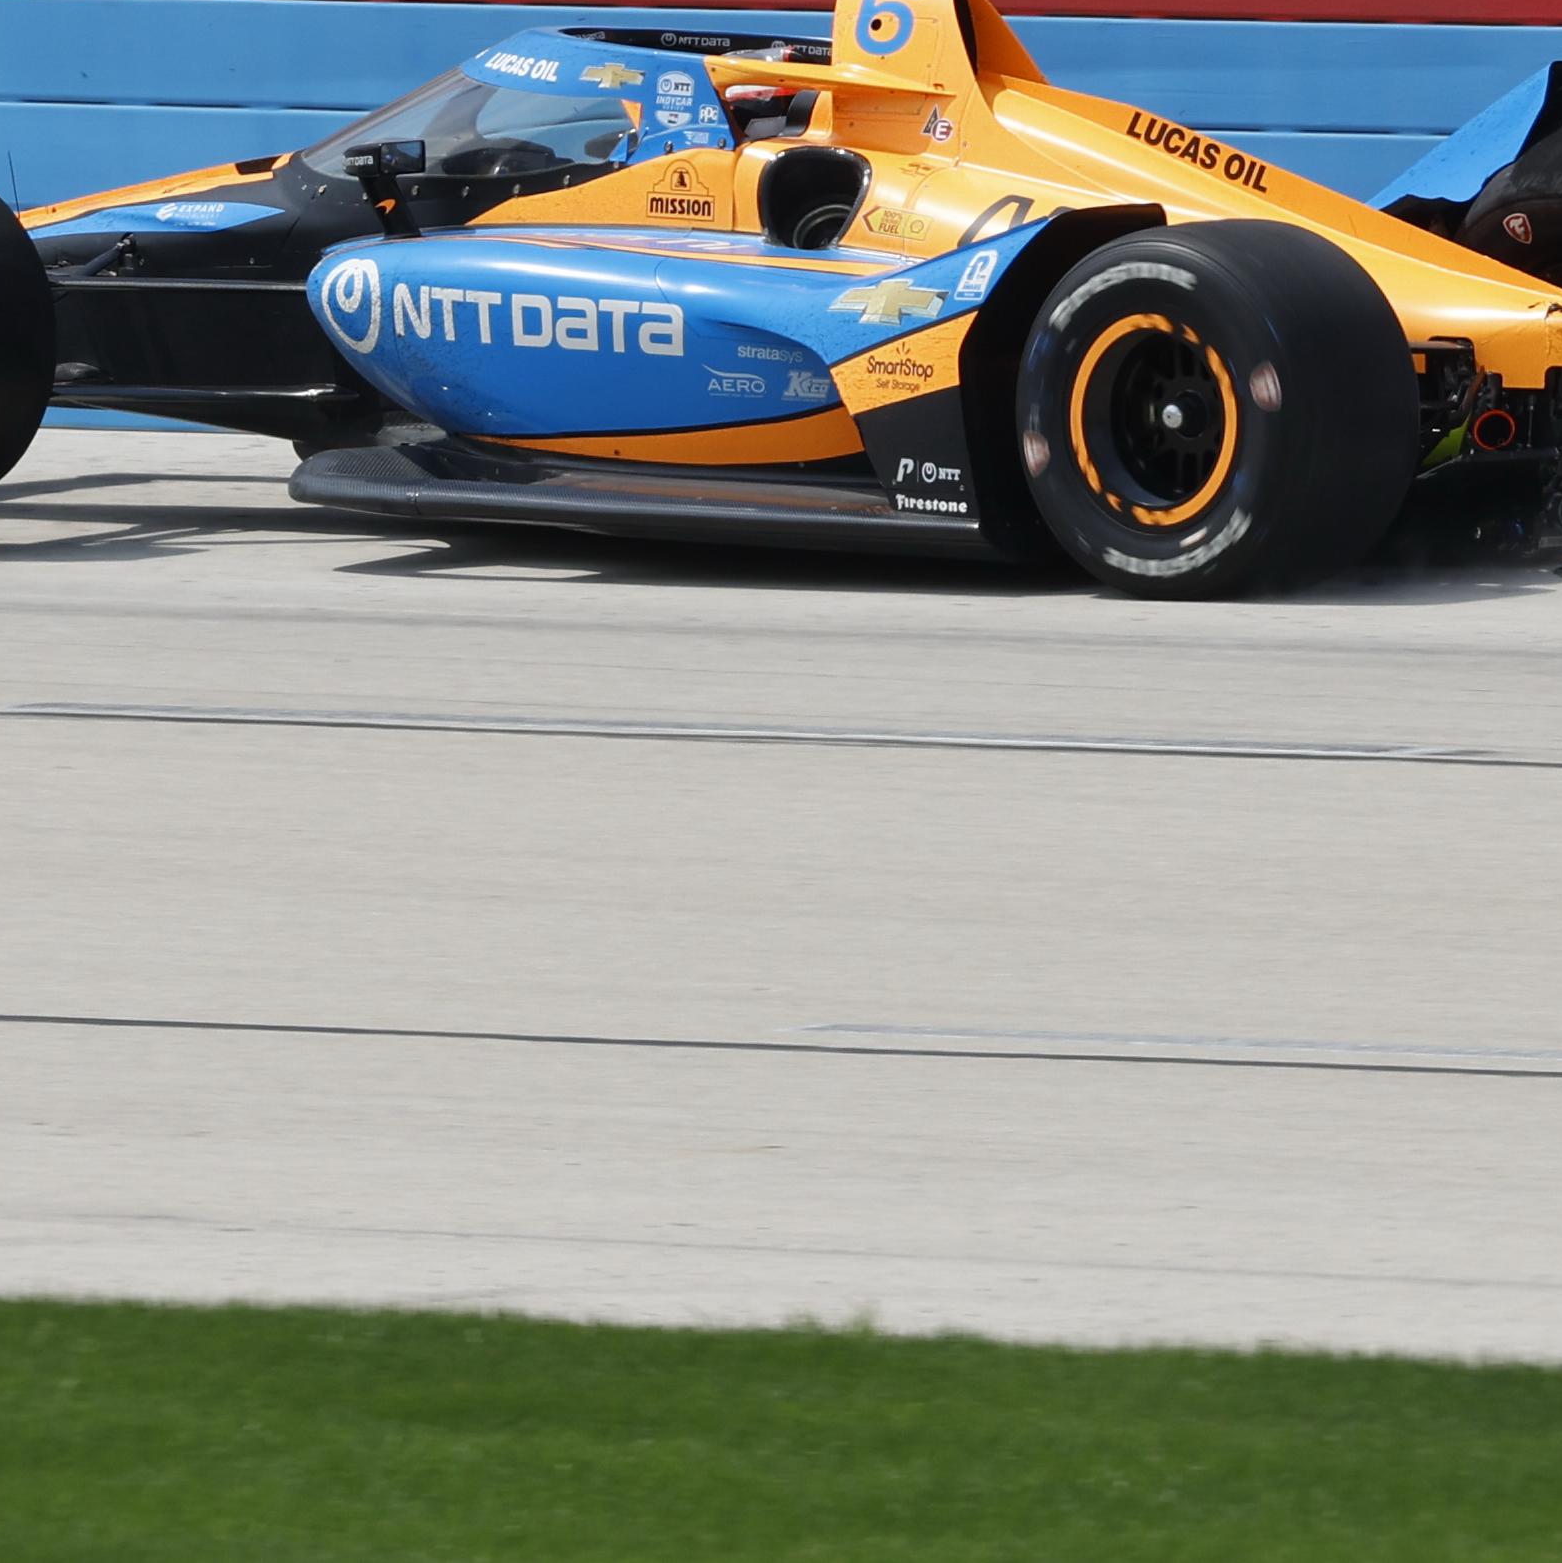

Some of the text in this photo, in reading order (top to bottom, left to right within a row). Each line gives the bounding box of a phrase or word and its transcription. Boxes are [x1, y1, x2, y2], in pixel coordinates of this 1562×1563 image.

[678, 36, 700, 46] NTT
[485, 52, 560, 83] LUCAS OIL
[674, 82, 691, 92] NTT
[656, 95, 693, 107] INDYCAR
[1126, 111, 1268, 194] LUCAS OIL
[178, 203, 225, 213] EXPAND
[649, 196, 712, 217] MISSION
[879, 222, 900, 235] FUEL
[393, 283, 502, 345] NTT
[738, 345, 804, 364] stratasys
[867, 355, 934, 382] SmartStop
[708, 378, 766, 394] AERO
[876, 377, 921, 394] Self Storage
[938, 467, 961, 481] NTT
[896, 493, 968, 514] Firestone
